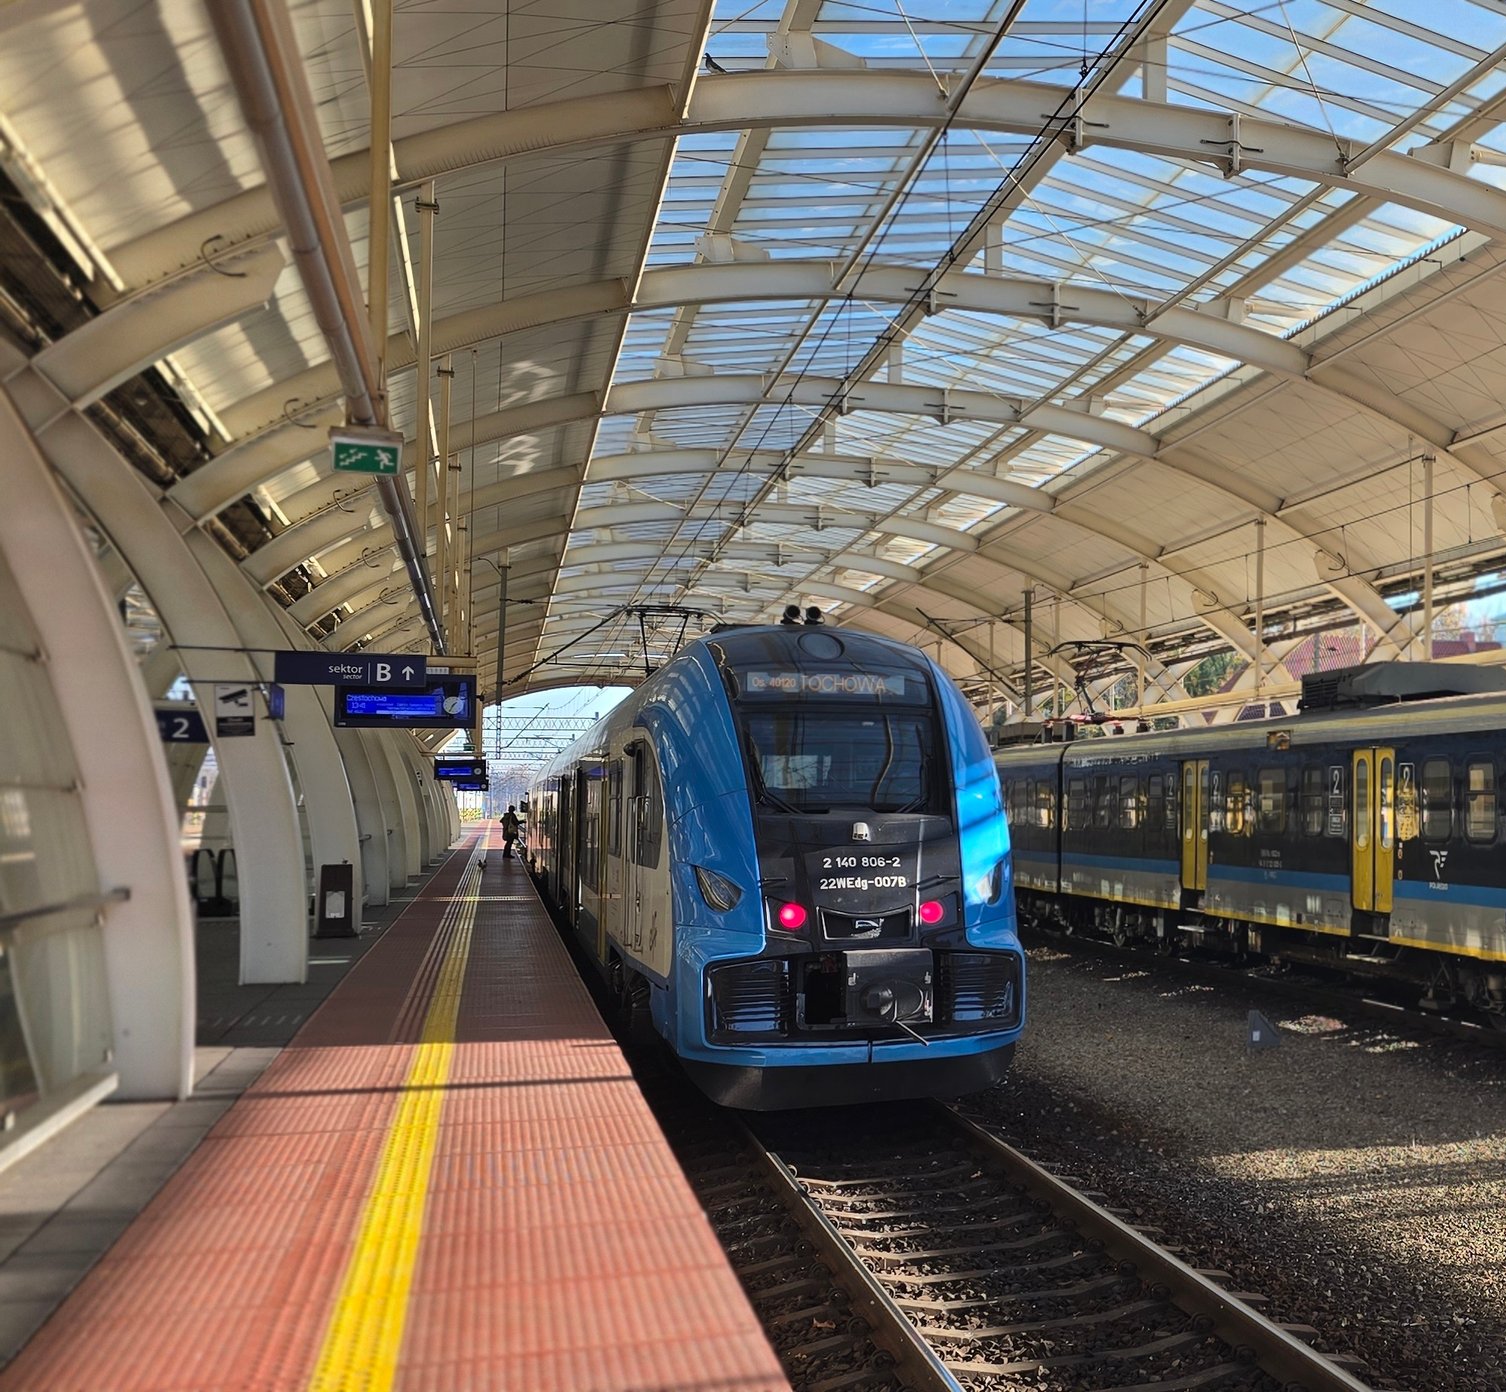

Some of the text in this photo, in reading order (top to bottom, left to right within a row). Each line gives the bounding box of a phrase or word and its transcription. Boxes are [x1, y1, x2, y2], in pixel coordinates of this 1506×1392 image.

[328, 663, 392, 682] sektor B
[769, 677, 796, 688] 40120
[800, 675, 887, 693] TOCHOWA
[171, 717, 190, 739] 2
[1332, 769, 1340, 794] 2
[1403, 766, 1411, 792] 2
[822, 856, 901, 869] 2 140 806-2
[819, 875, 907, 890] 22WEdg-007B
